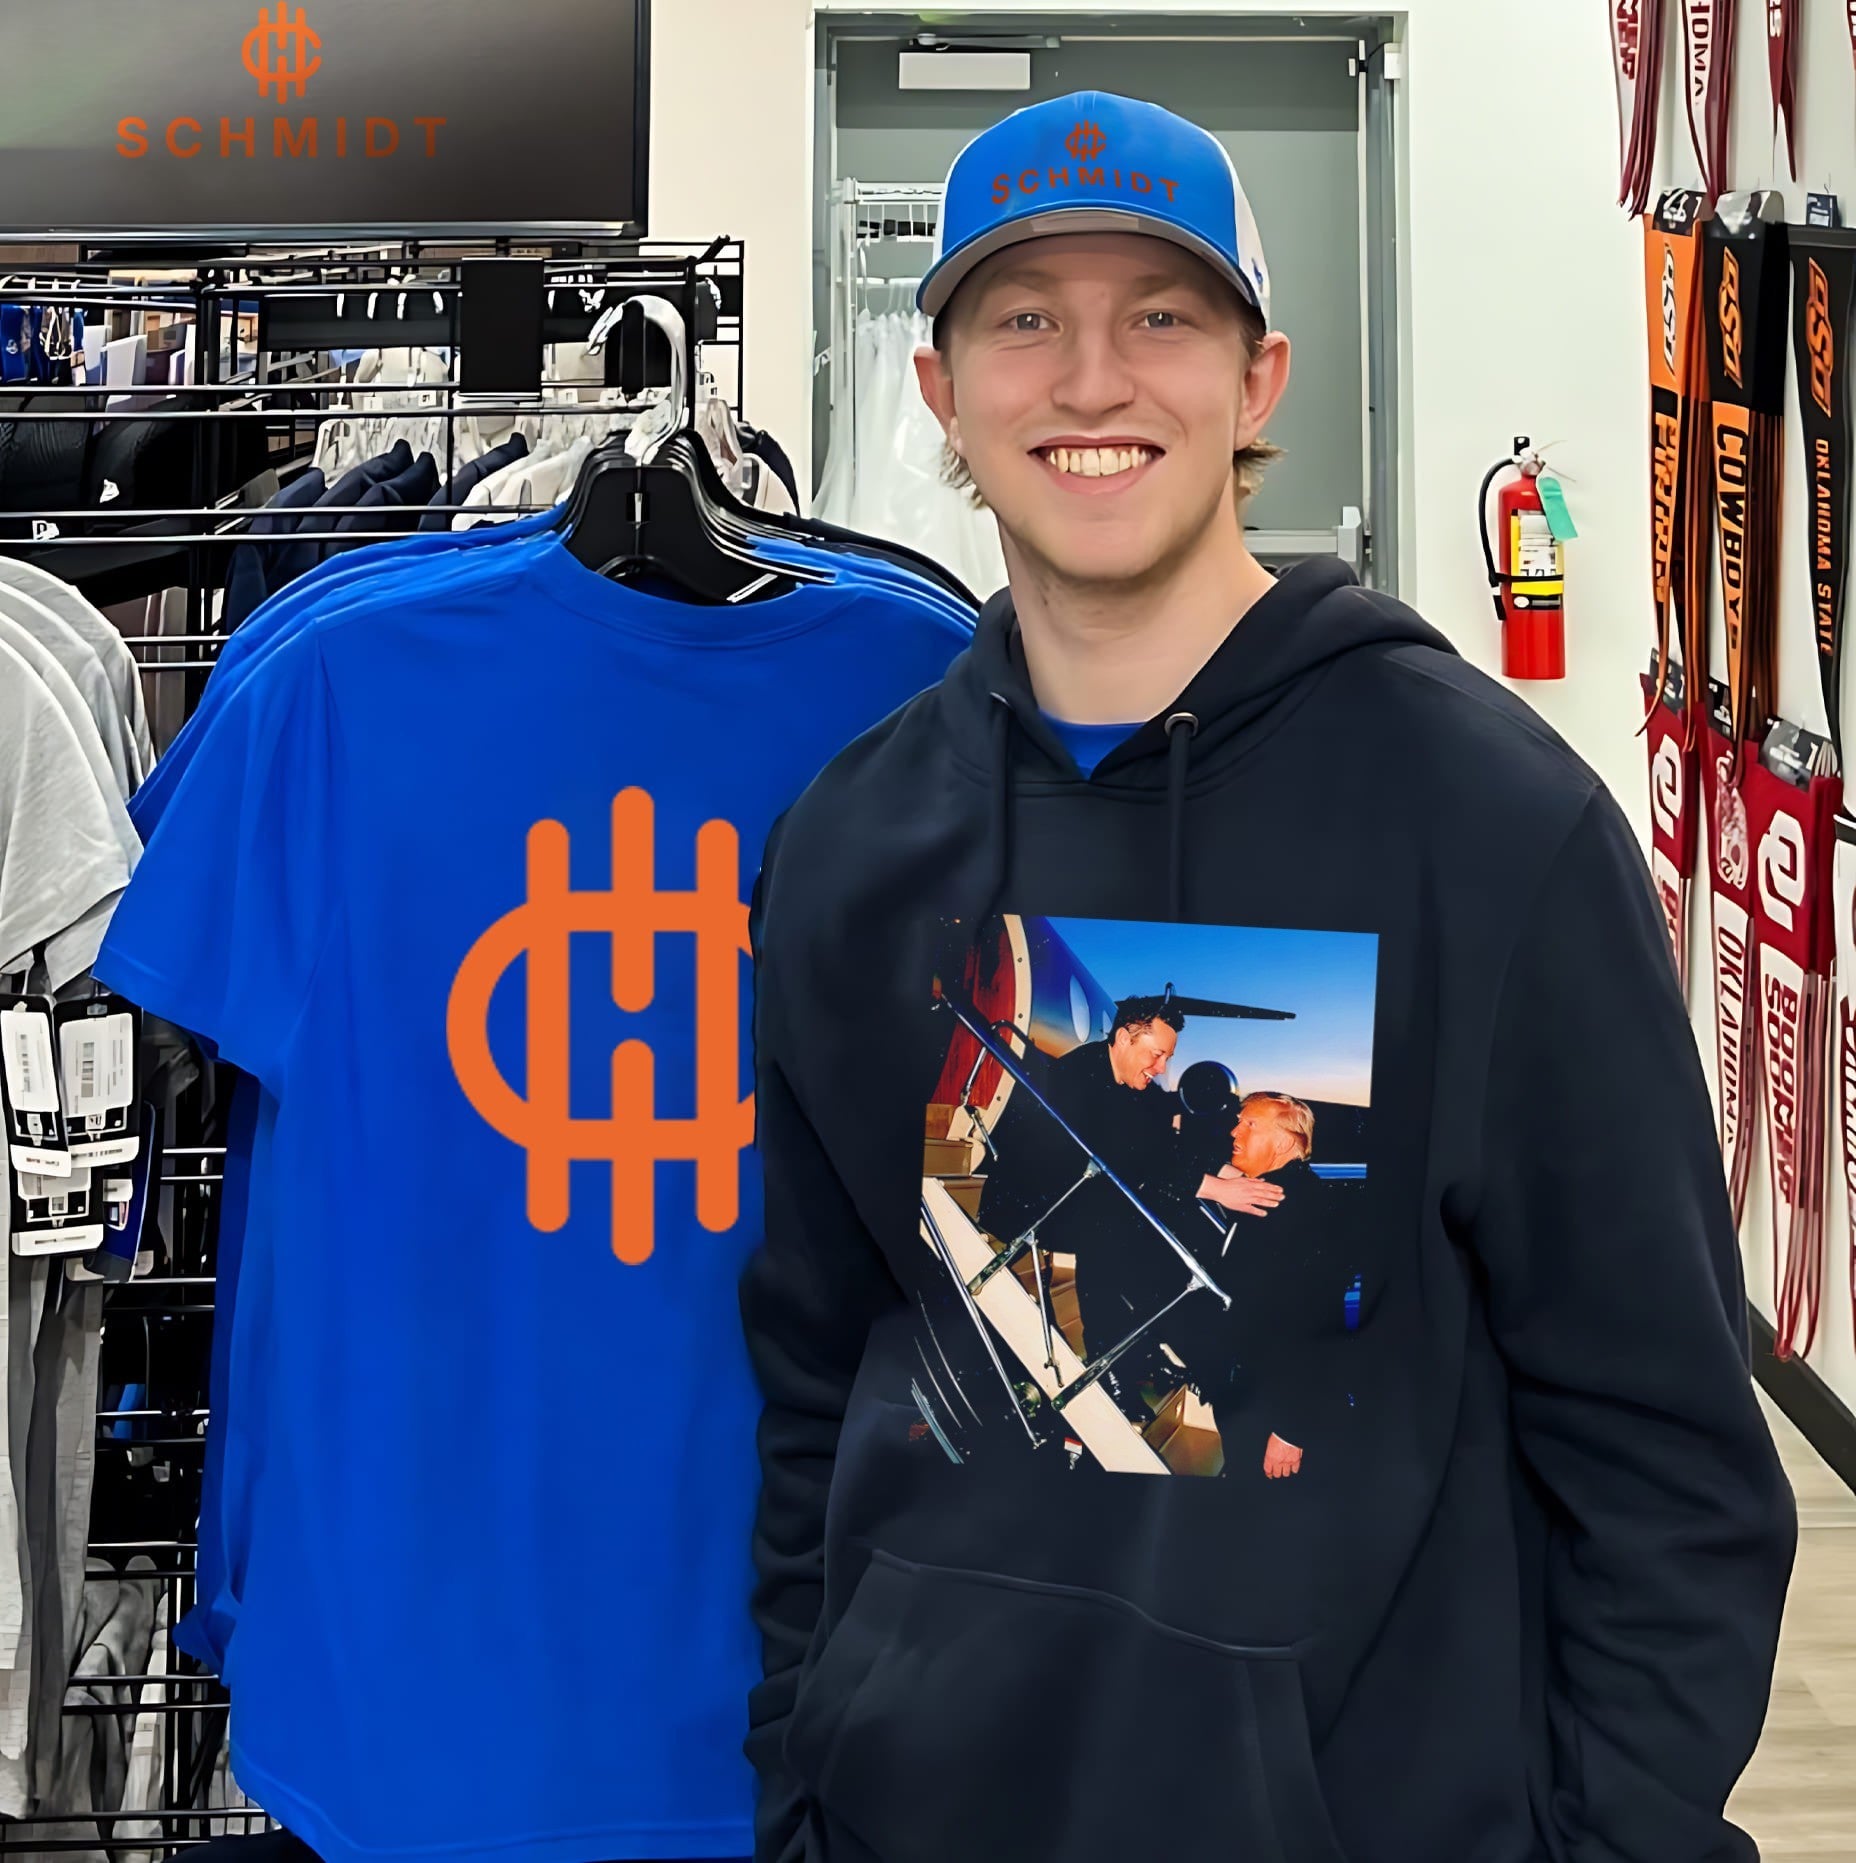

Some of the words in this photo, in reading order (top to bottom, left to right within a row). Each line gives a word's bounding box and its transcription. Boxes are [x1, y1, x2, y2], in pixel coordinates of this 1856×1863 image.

[115, 116, 447, 159] SCHMIDT
[991, 166, 1179, 205] SCHMIDT
[1815, 438, 1833, 570] OKLAHOMA
[1717, 926, 1747, 1144] OKLAHOMA
